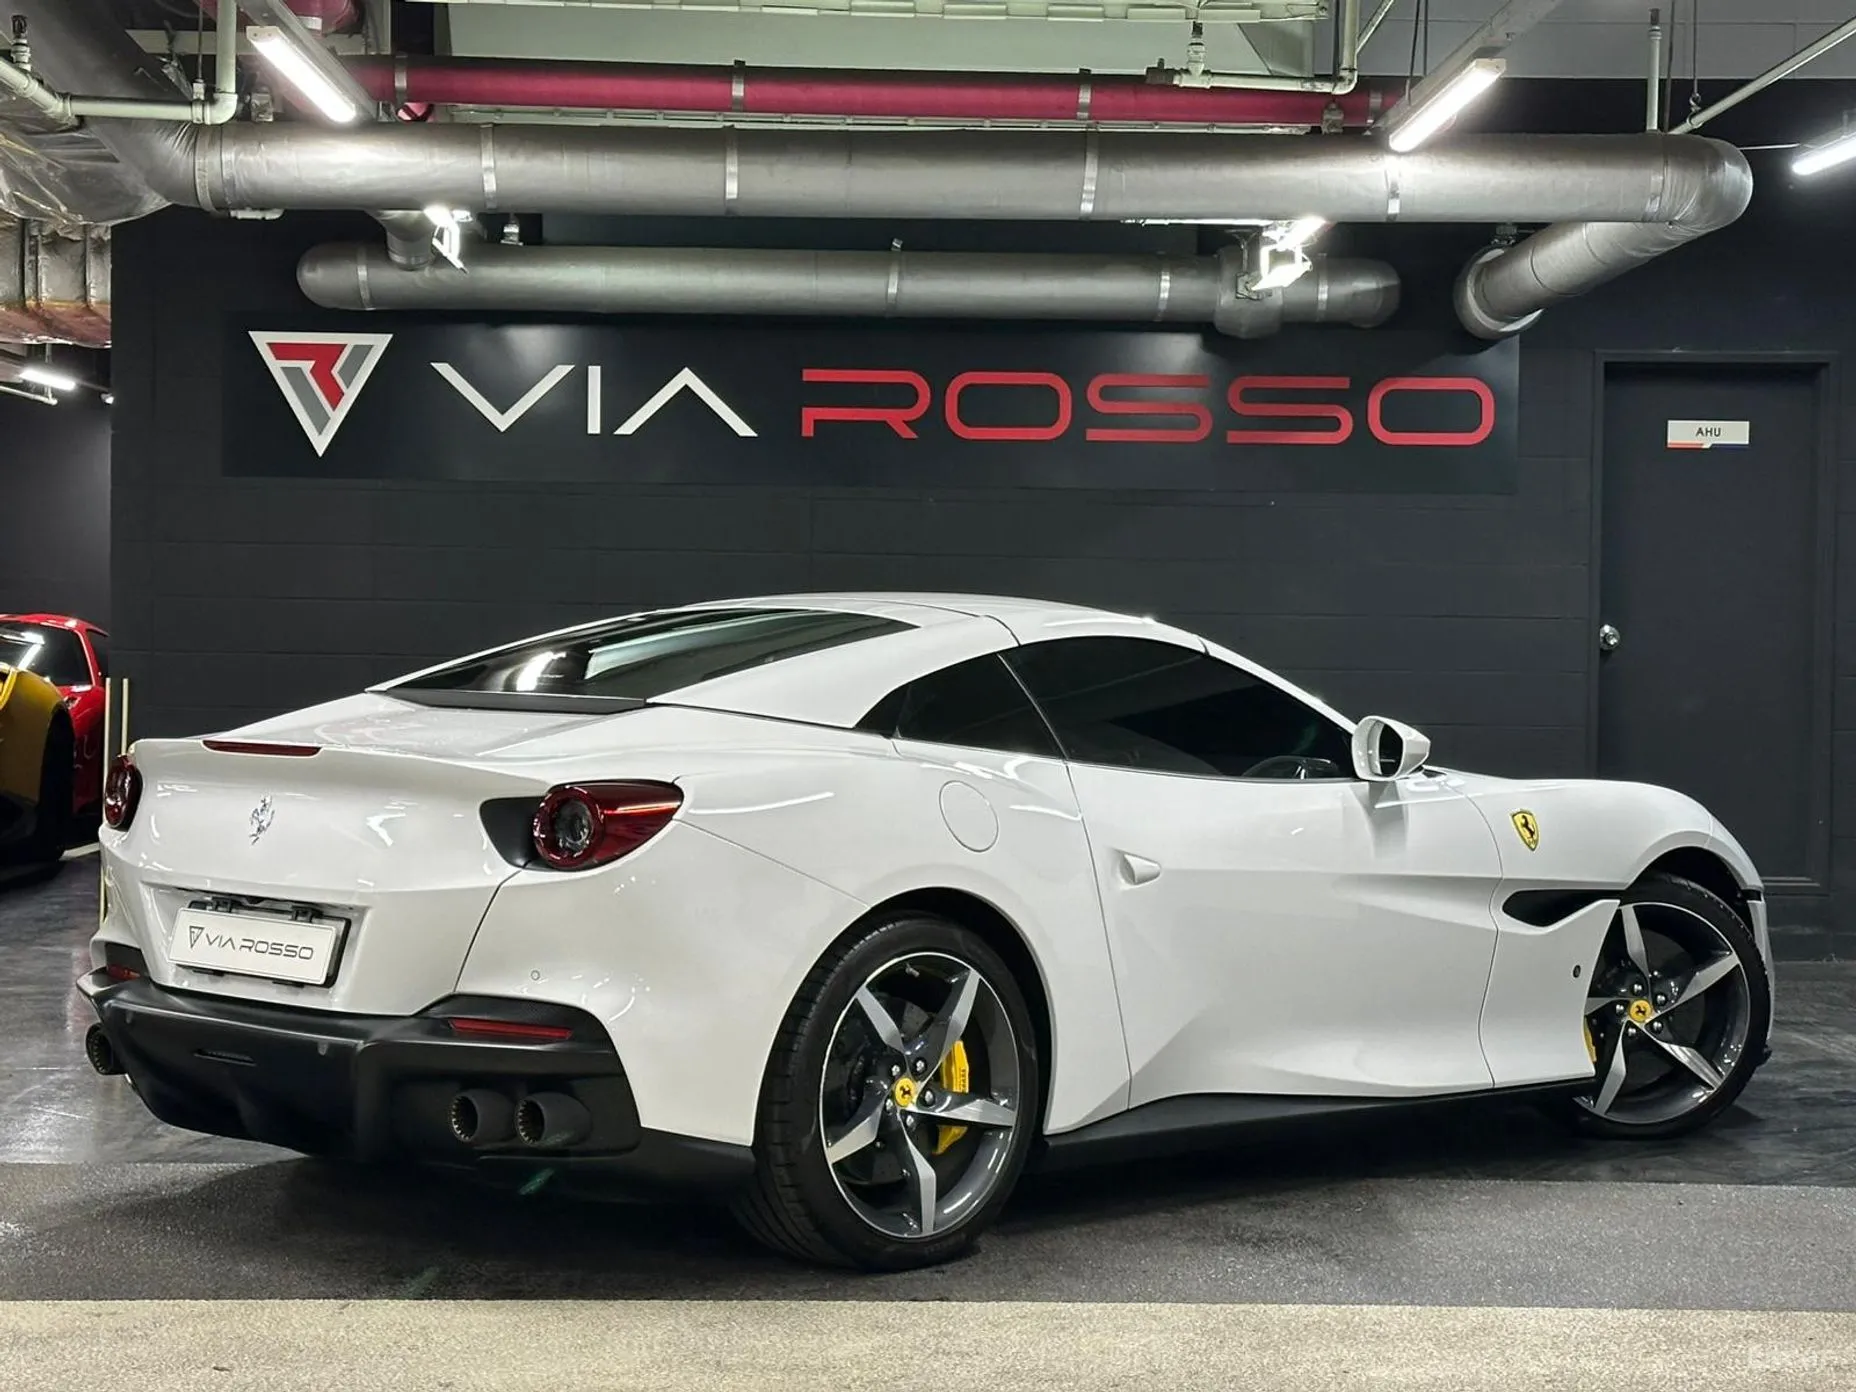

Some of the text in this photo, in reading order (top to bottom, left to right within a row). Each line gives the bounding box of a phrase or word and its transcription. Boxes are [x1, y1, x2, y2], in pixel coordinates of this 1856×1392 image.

[430, 361, 1495, 446] VIA ROSSO
[1695, 427, 1721, 438] AHU
[205, 933, 314, 961] VIA ROSSO
